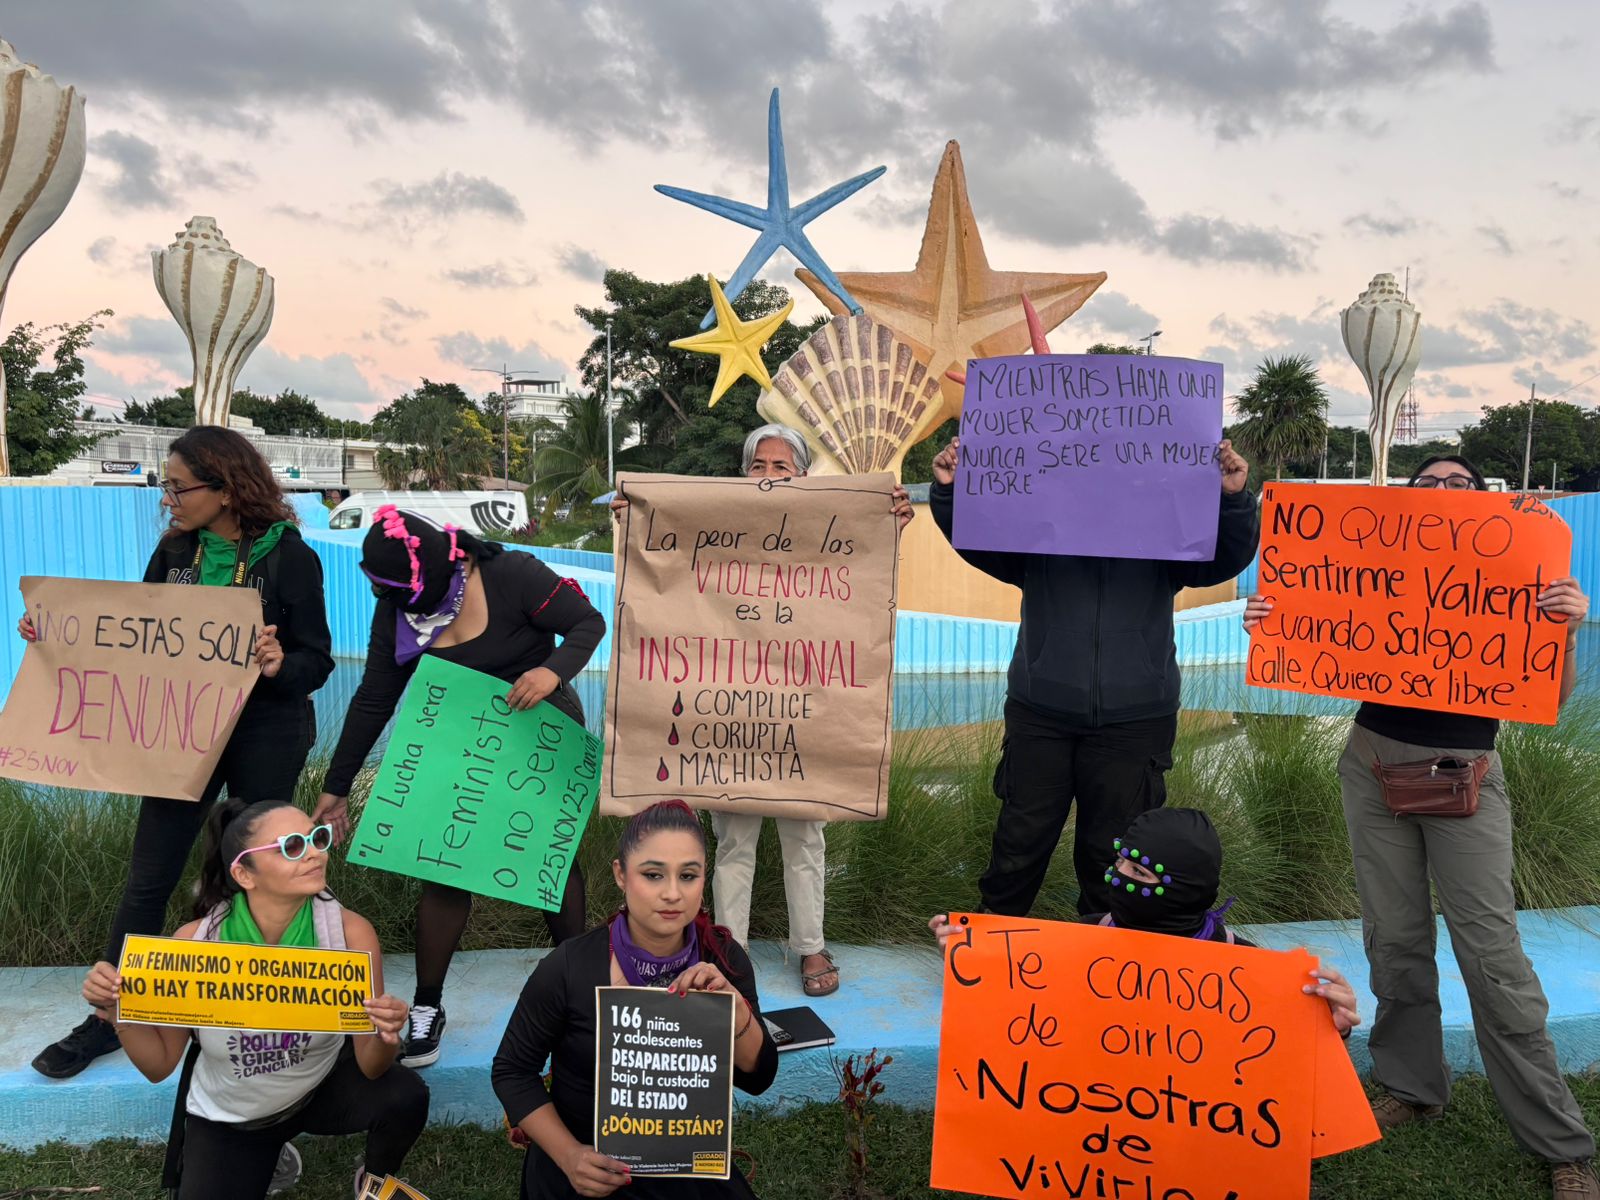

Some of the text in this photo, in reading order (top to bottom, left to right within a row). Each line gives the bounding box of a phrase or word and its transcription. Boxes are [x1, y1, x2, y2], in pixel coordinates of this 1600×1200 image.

[1116, 364, 1170, 402] HAYA
[1178, 371, 1216, 399] UNA
[961, 403, 1173, 436] MUJER SOMETIDA
[962, 440, 1221, 469] NUNCA SERE UNA MUJER
[644, 508, 854, 572] La peor de las
[695, 559, 851, 602] VIOLENCIAS
[1262, 546, 1406, 598] Sentirme
[735, 601, 793, 624] es la
[94, 615, 185, 658] ESTAS
[1481, 632, 1505, 670] a
[1522, 621, 1560, 681] la
[638, 636, 868, 689] INSTITUCIONAL
[1311, 651, 1393, 694] Quiero
[694, 689, 814, 720] COMPLICE
[691, 722, 798, 752] CORUPTA
[376, 742, 424, 809] Lucha
[416, 694, 514, 869] Feminista
[679, 751, 805, 786] MACHISTA
[503, 810, 534, 852] no
[493, 867, 519, 889] o
[125, 952, 144, 969] SIN
[145, 951, 232, 976] FEMINISMO
[249, 957, 366, 983] ORGANIZACIÓN
[121, 976, 366, 1008] NO HAY TRANSFORMACIÓN
[1086, 955, 1252, 1024] cansas
[611, 1005, 680, 1032] 166 niñas
[1007, 1003, 1063, 1048] de
[612, 1030, 703, 1049] y adolescentes
[241, 1049, 300, 1067] GIRLS
[611, 1048, 717, 1073] DESAPARECIDAS
[611, 1067, 710, 1089] bajo la custodia
[610, 1087, 688, 1111] DEL ESTADO
[601, 1112, 725, 1137] ¿DÓNDE ESTÁN?
[1082, 1123, 1155, 1165] de
